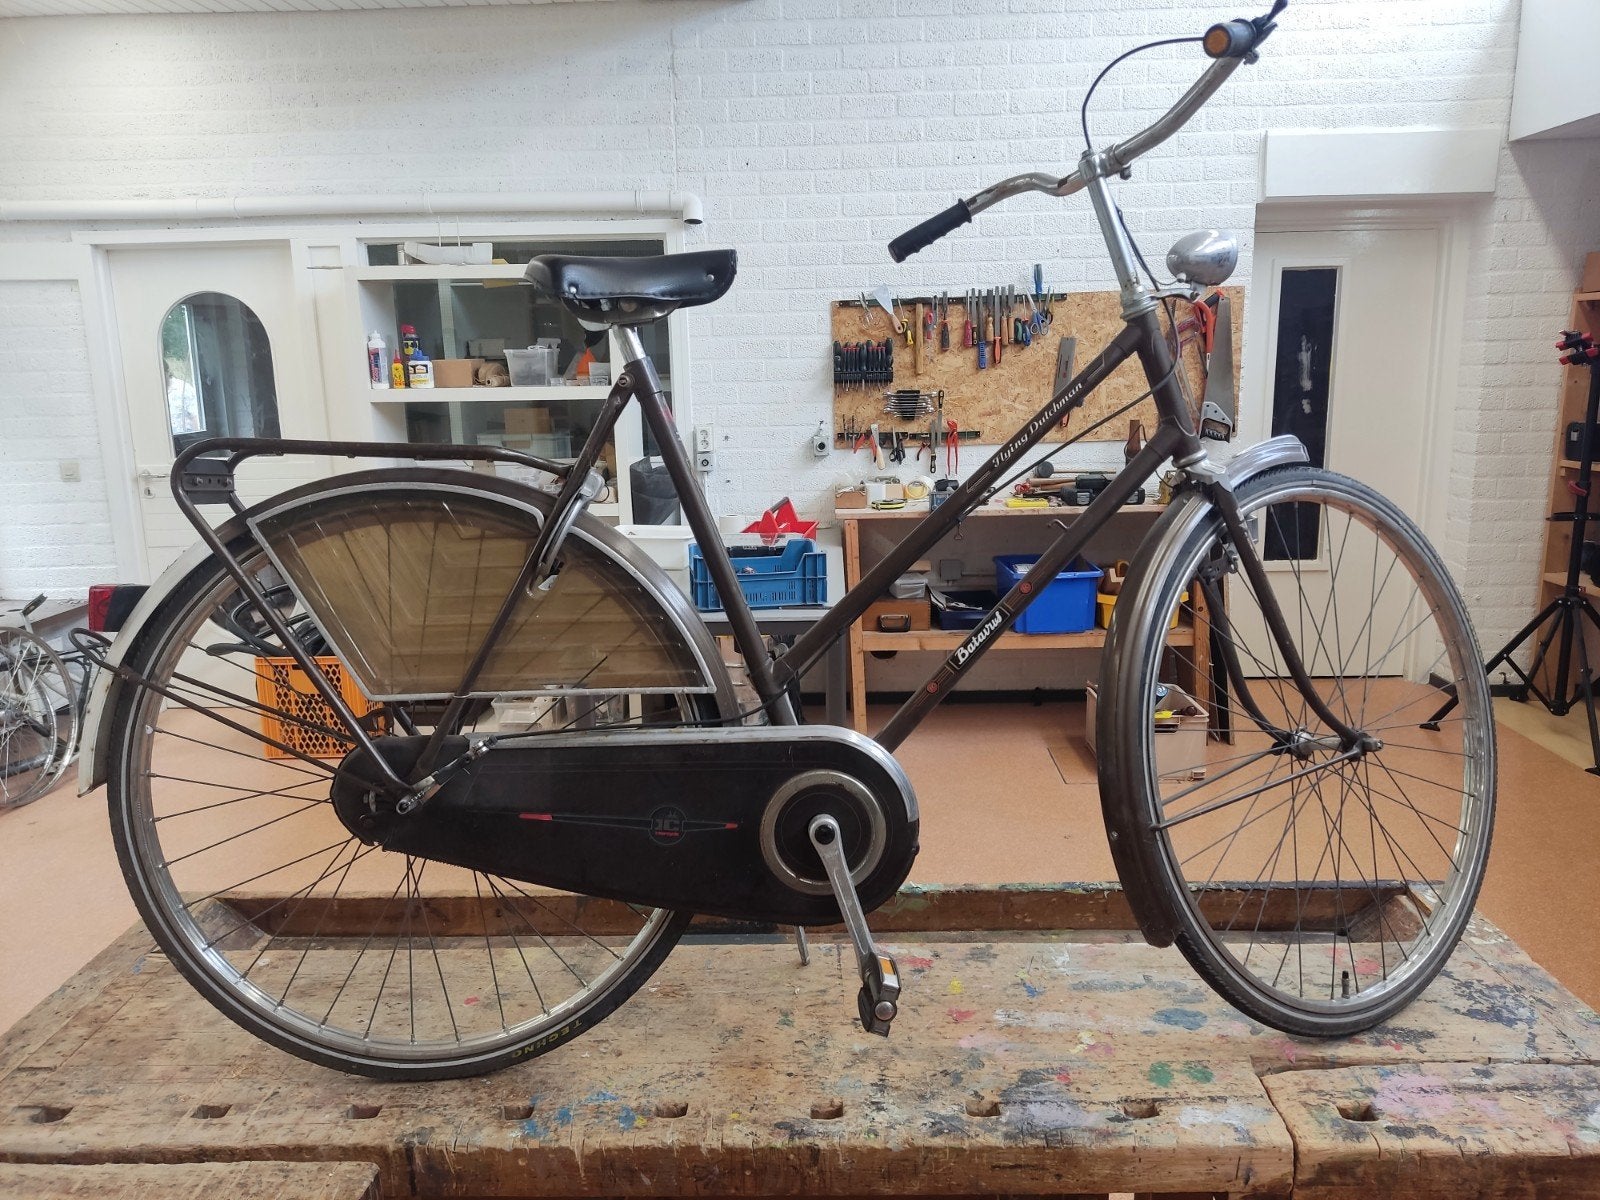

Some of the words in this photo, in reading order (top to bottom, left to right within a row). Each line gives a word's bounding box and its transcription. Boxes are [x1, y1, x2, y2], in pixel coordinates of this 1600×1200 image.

[992, 433, 1029, 468] Flying
[1029, 382, 1083, 435] Dutchman
[954, 610, 1003, 665] Batavus
[512, 1019, 583, 1058] TECHNO
